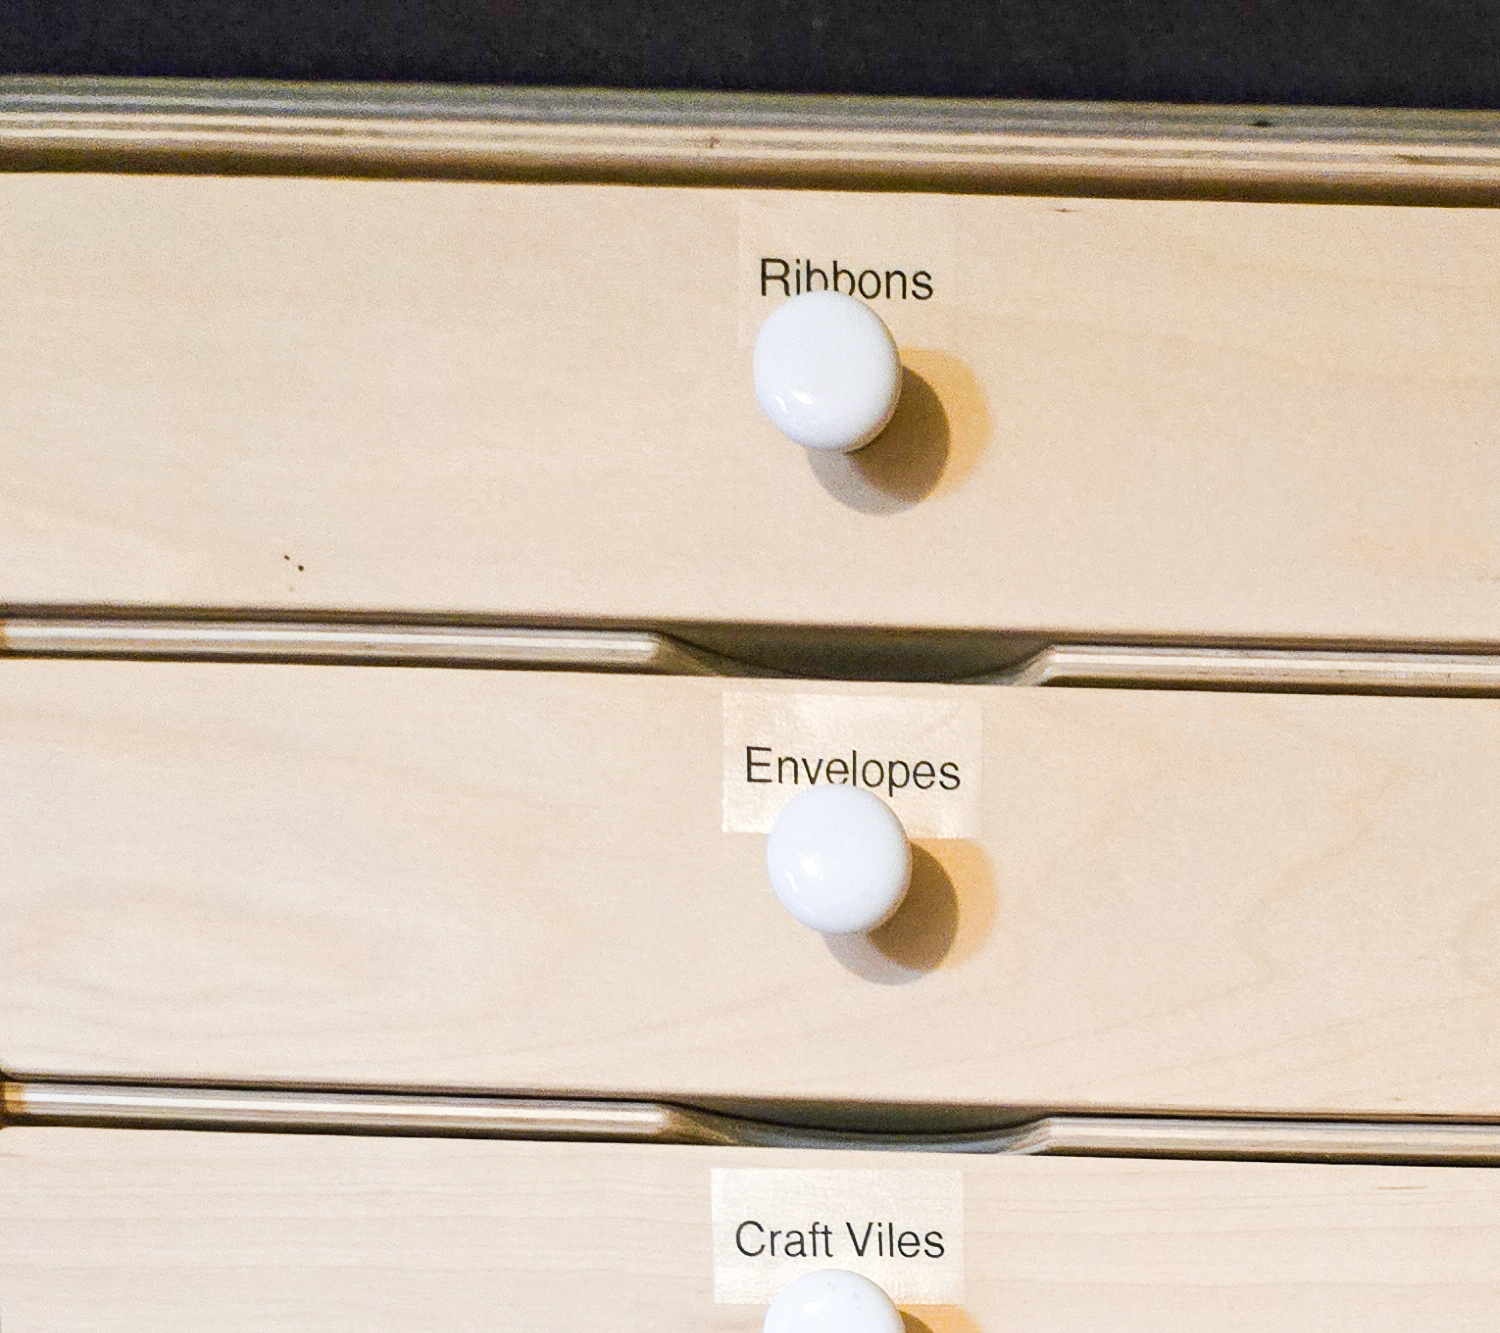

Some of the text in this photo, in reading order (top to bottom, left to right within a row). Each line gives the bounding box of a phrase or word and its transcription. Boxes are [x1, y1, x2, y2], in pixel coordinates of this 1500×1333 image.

[760, 257, 934, 301] Ribbons
[746, 745, 961, 798] Envelopes
[735, 1220, 945, 1259] Craft Viles
